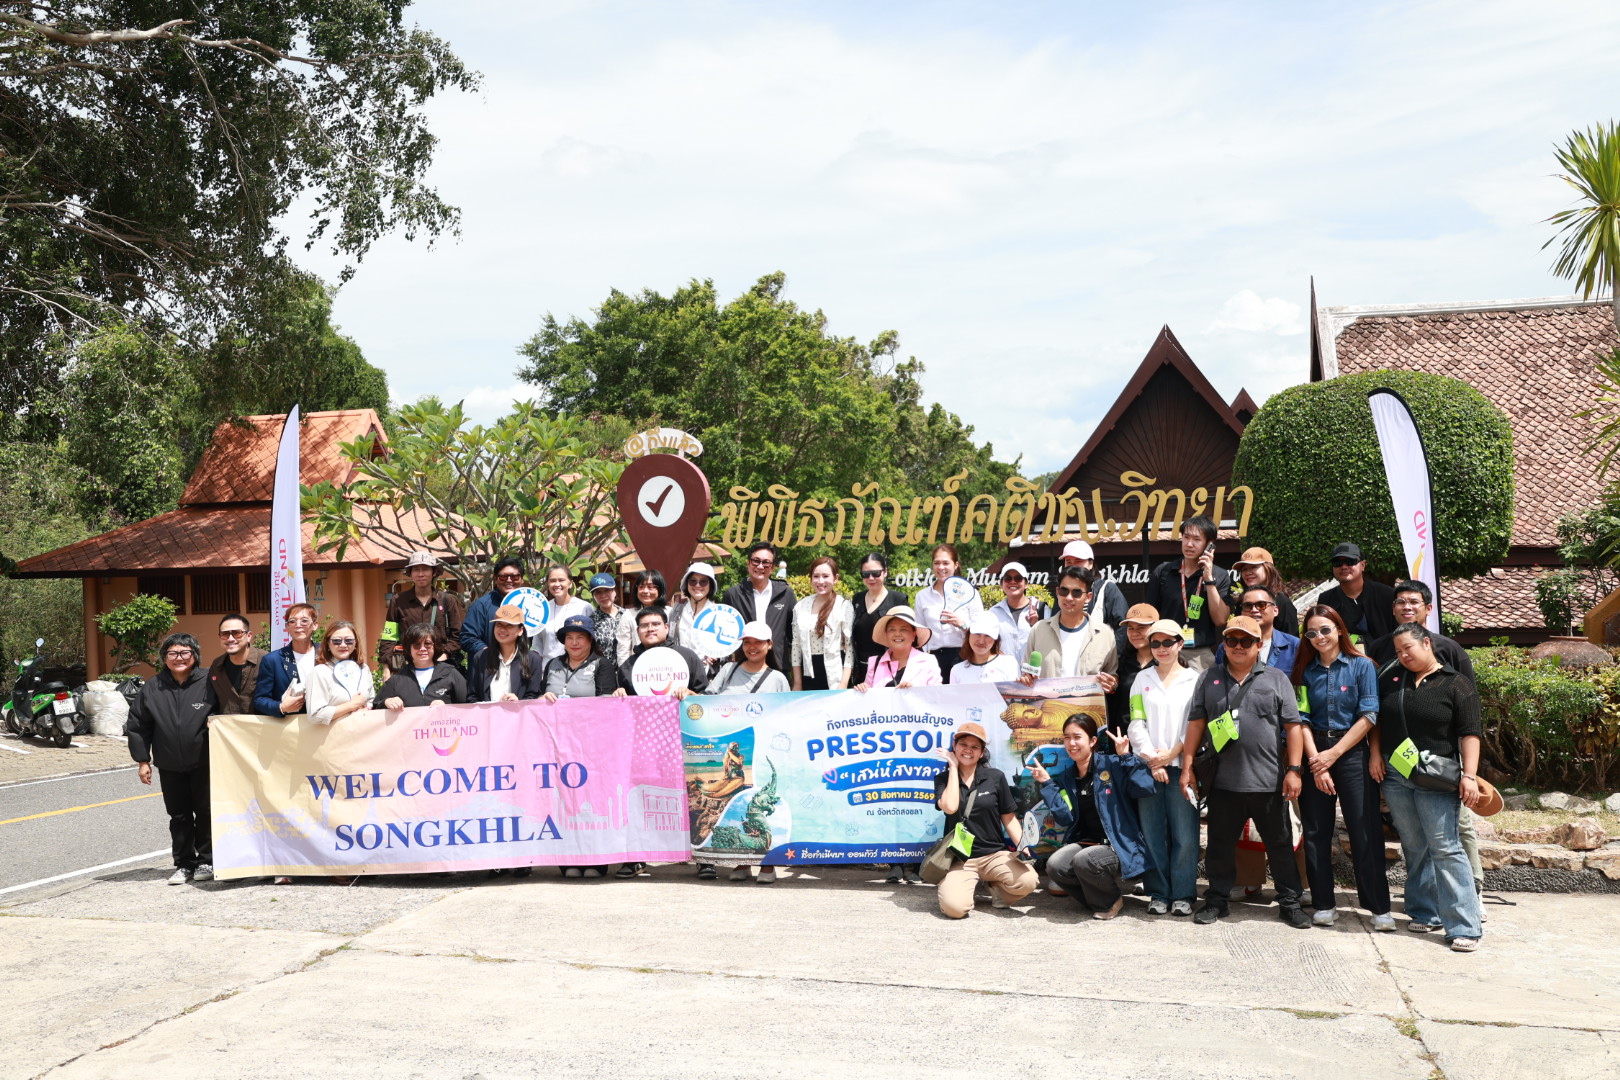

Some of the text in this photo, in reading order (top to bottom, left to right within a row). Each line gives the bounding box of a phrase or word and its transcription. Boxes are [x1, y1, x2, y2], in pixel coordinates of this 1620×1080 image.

[720, 467, 1254, 549] พิพิธภัณฑ์คติชนวิทยา
[634, 672, 688, 682] THAILAND
[430, 717, 461, 726] amazing
[826, 710, 954, 730] กิจกรรมสื่อมวลชนสัญจร
[412, 725, 478, 739] THAILAND
[806, 729, 955, 761] PRESSTOU
[305, 761, 588, 801] WELCOME TO
[865, 789, 935, 801] 30 สิงหาคม 2569
[877, 807, 923, 816] จังหวัดสงขลา
[334, 814, 563, 852] SONGKHLA
